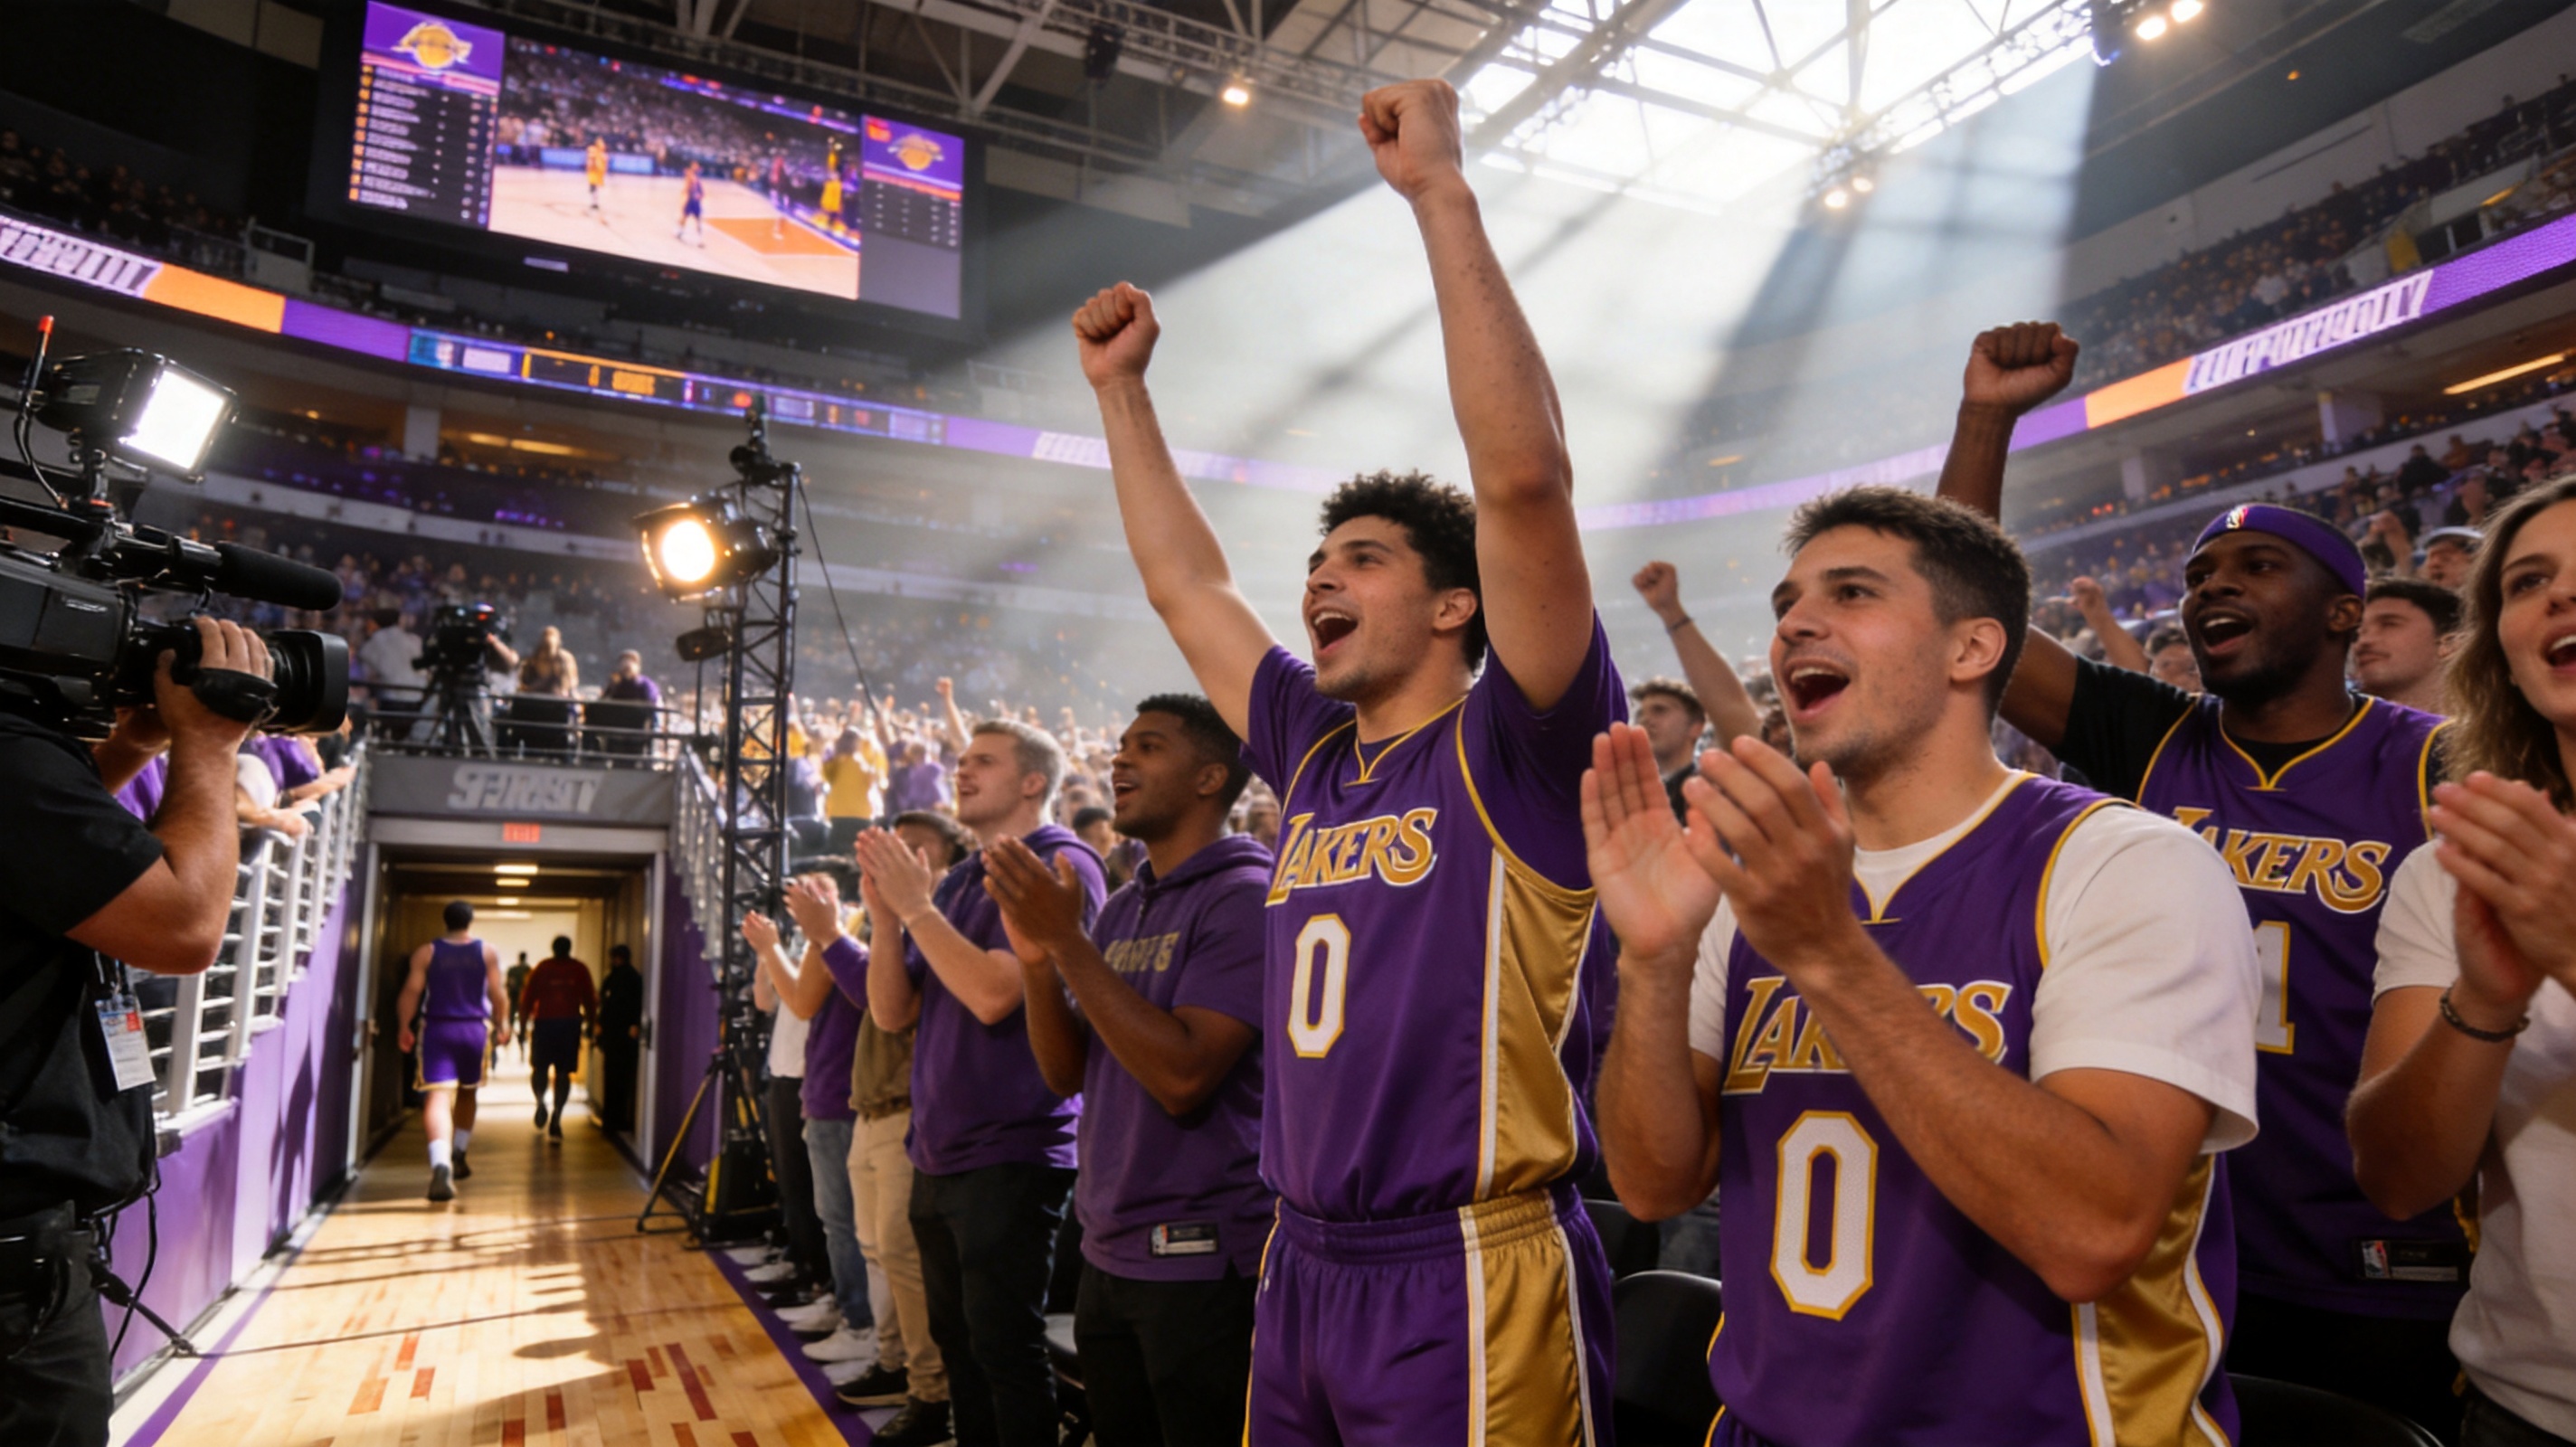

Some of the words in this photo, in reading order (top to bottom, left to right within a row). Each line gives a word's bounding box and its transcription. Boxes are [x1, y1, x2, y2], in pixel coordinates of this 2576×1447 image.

[1264, 807, 1439, 907] LAKERS
[2172, 805, 2392, 914] KERS
[1287, 913, 1351, 1058] 0
[1769, 1110, 1879, 1321] 0
